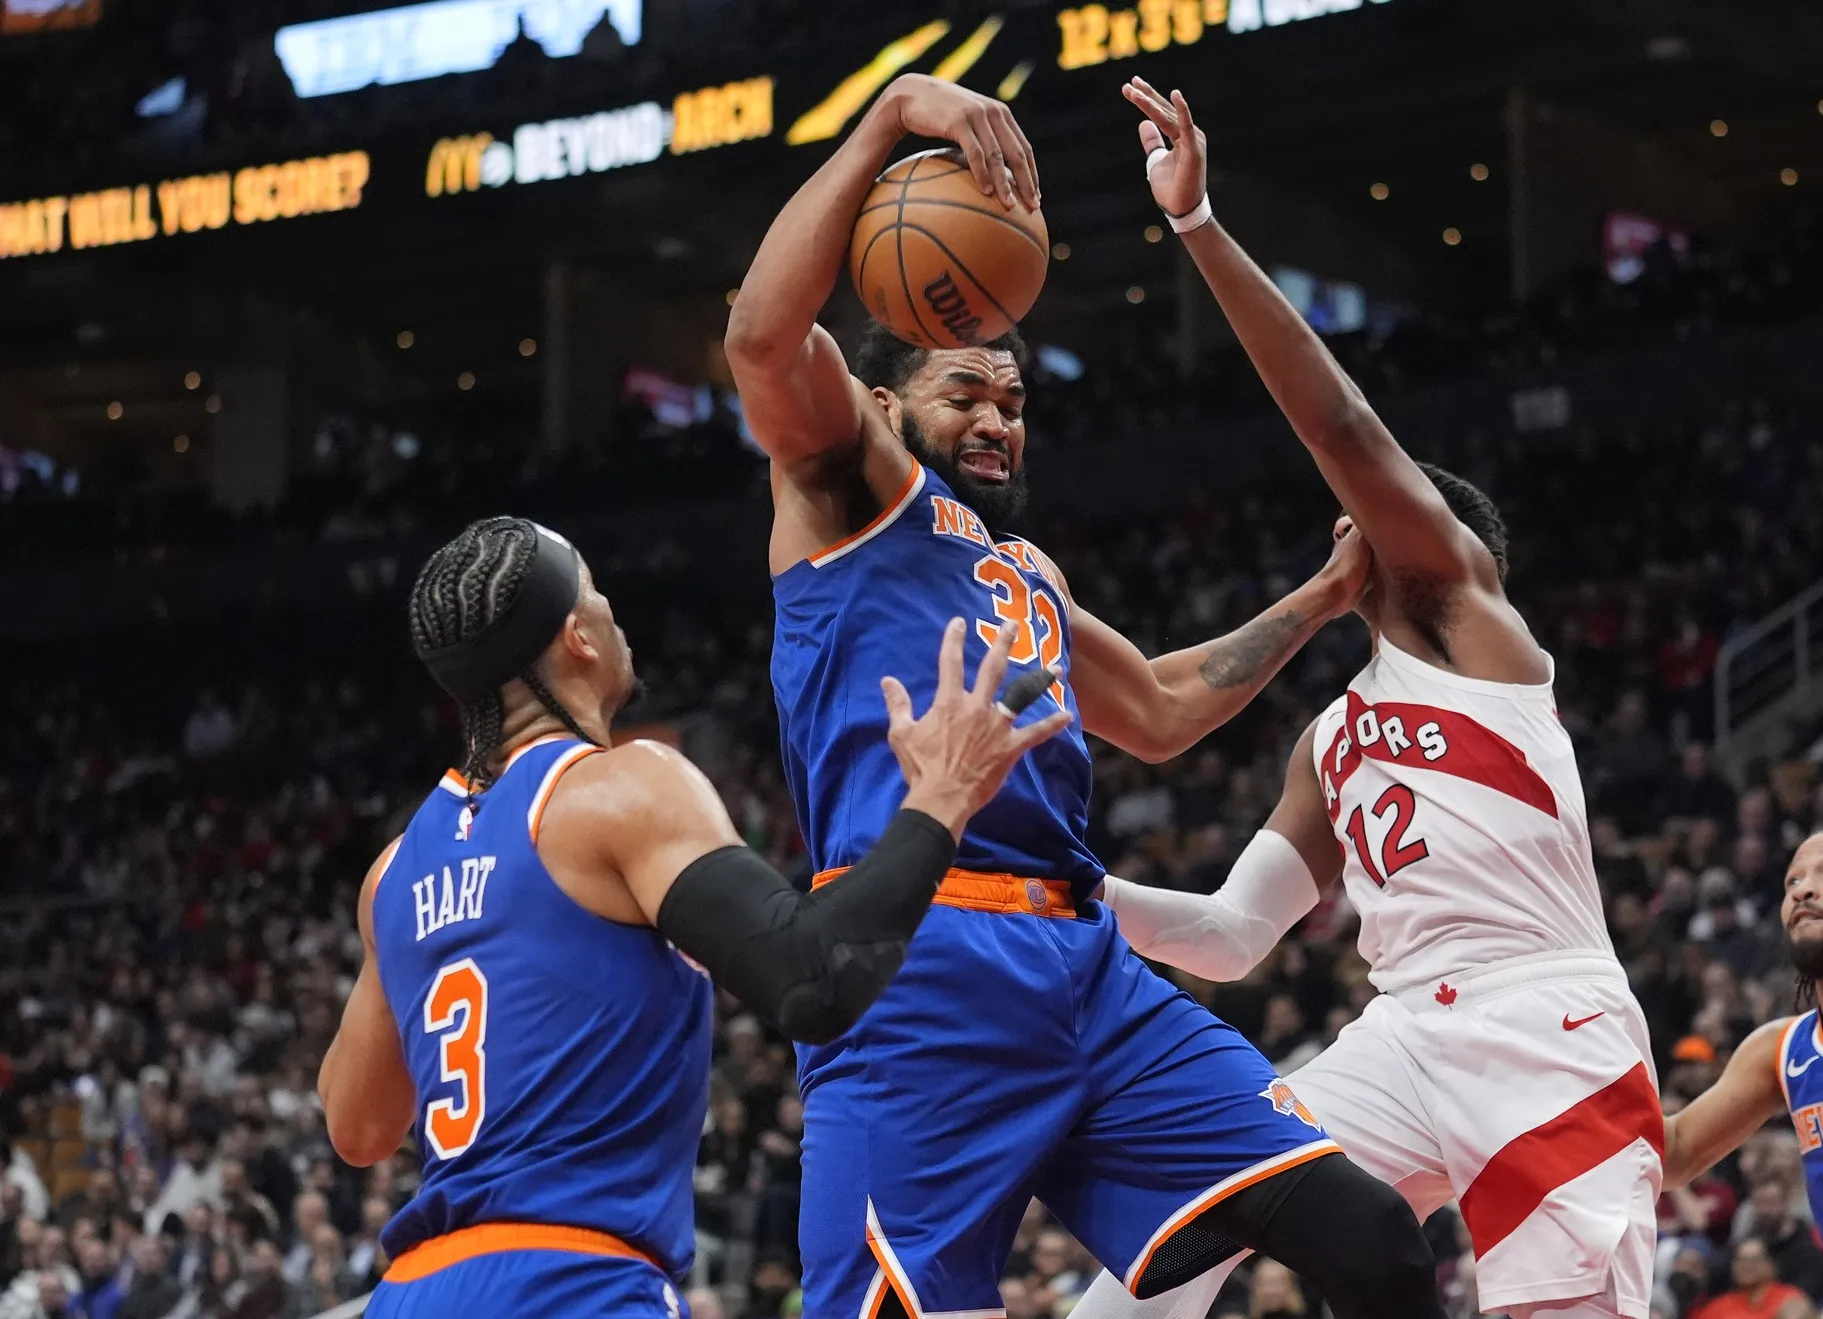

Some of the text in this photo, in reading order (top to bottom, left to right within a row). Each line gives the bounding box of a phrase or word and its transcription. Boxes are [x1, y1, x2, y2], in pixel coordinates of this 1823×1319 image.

[513, 100, 666, 184] BEYOND
[671, 74, 774, 155] ARCH
[69, 183, 157, 250] WILL
[157, 170, 231, 236] YOU
[234, 150, 370, 224] SCORE?
[930, 495, 1001, 559] NE
[973, 554, 1065, 712] 32
[1345, 783, 1430, 889] 12
[412, 855, 497, 942] HART
[424, 957, 488, 1160] 3
